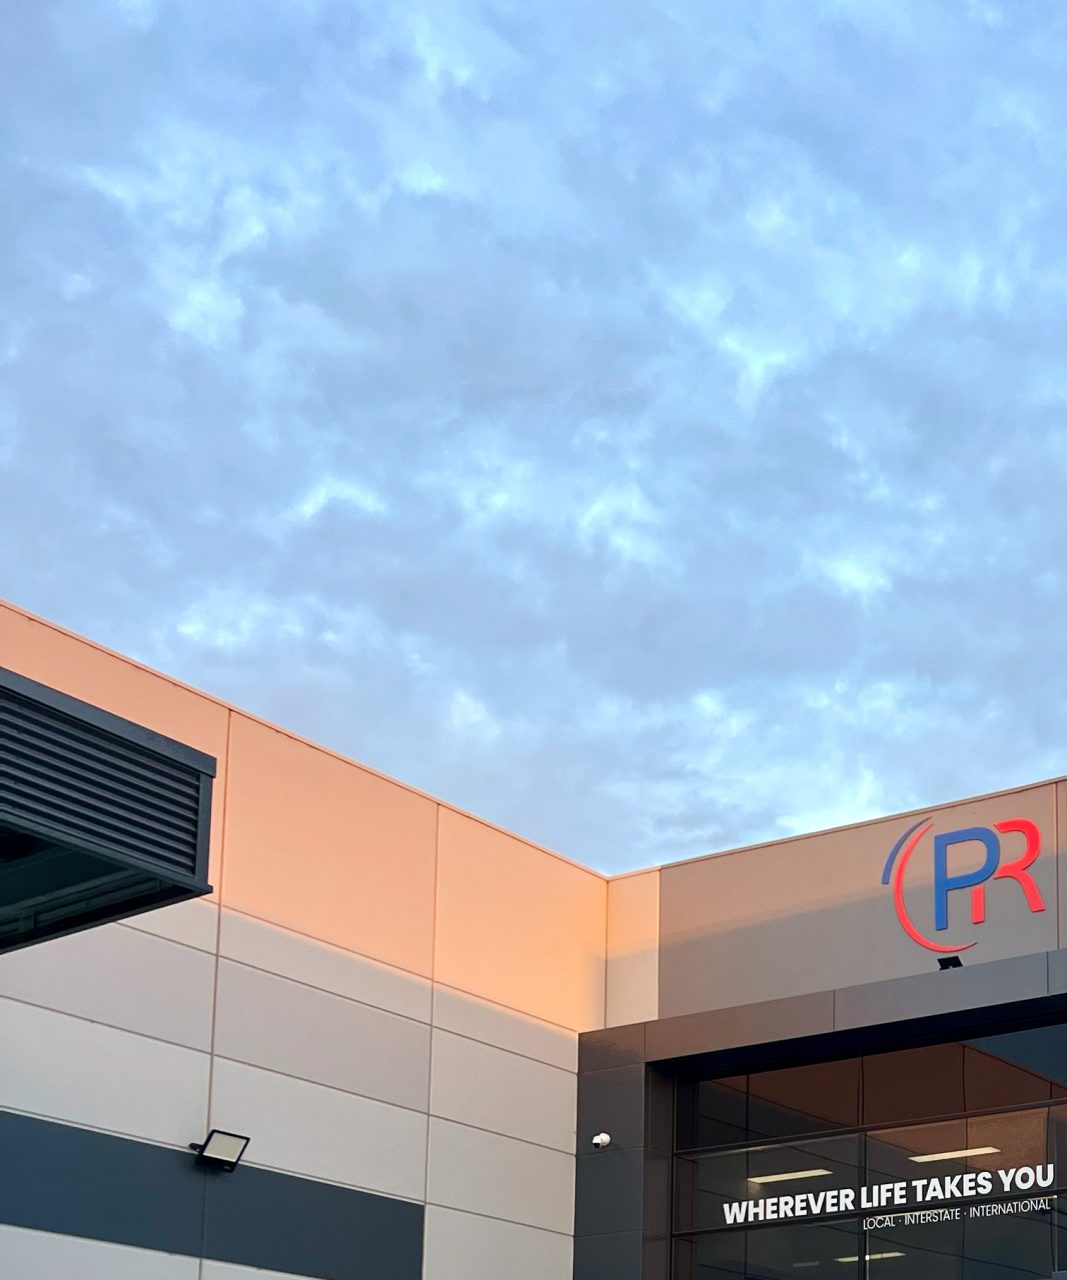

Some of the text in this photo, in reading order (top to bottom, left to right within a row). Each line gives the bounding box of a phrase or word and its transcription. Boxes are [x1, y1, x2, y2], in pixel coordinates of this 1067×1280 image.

[933, 816, 1046, 931] PR
[723, 1163, 1054, 1225] WHEREVER LIFE TAKES YOU
[863, 1199, 1051, 1230] LOCAL INTERSTATE INTERNATIONAL
